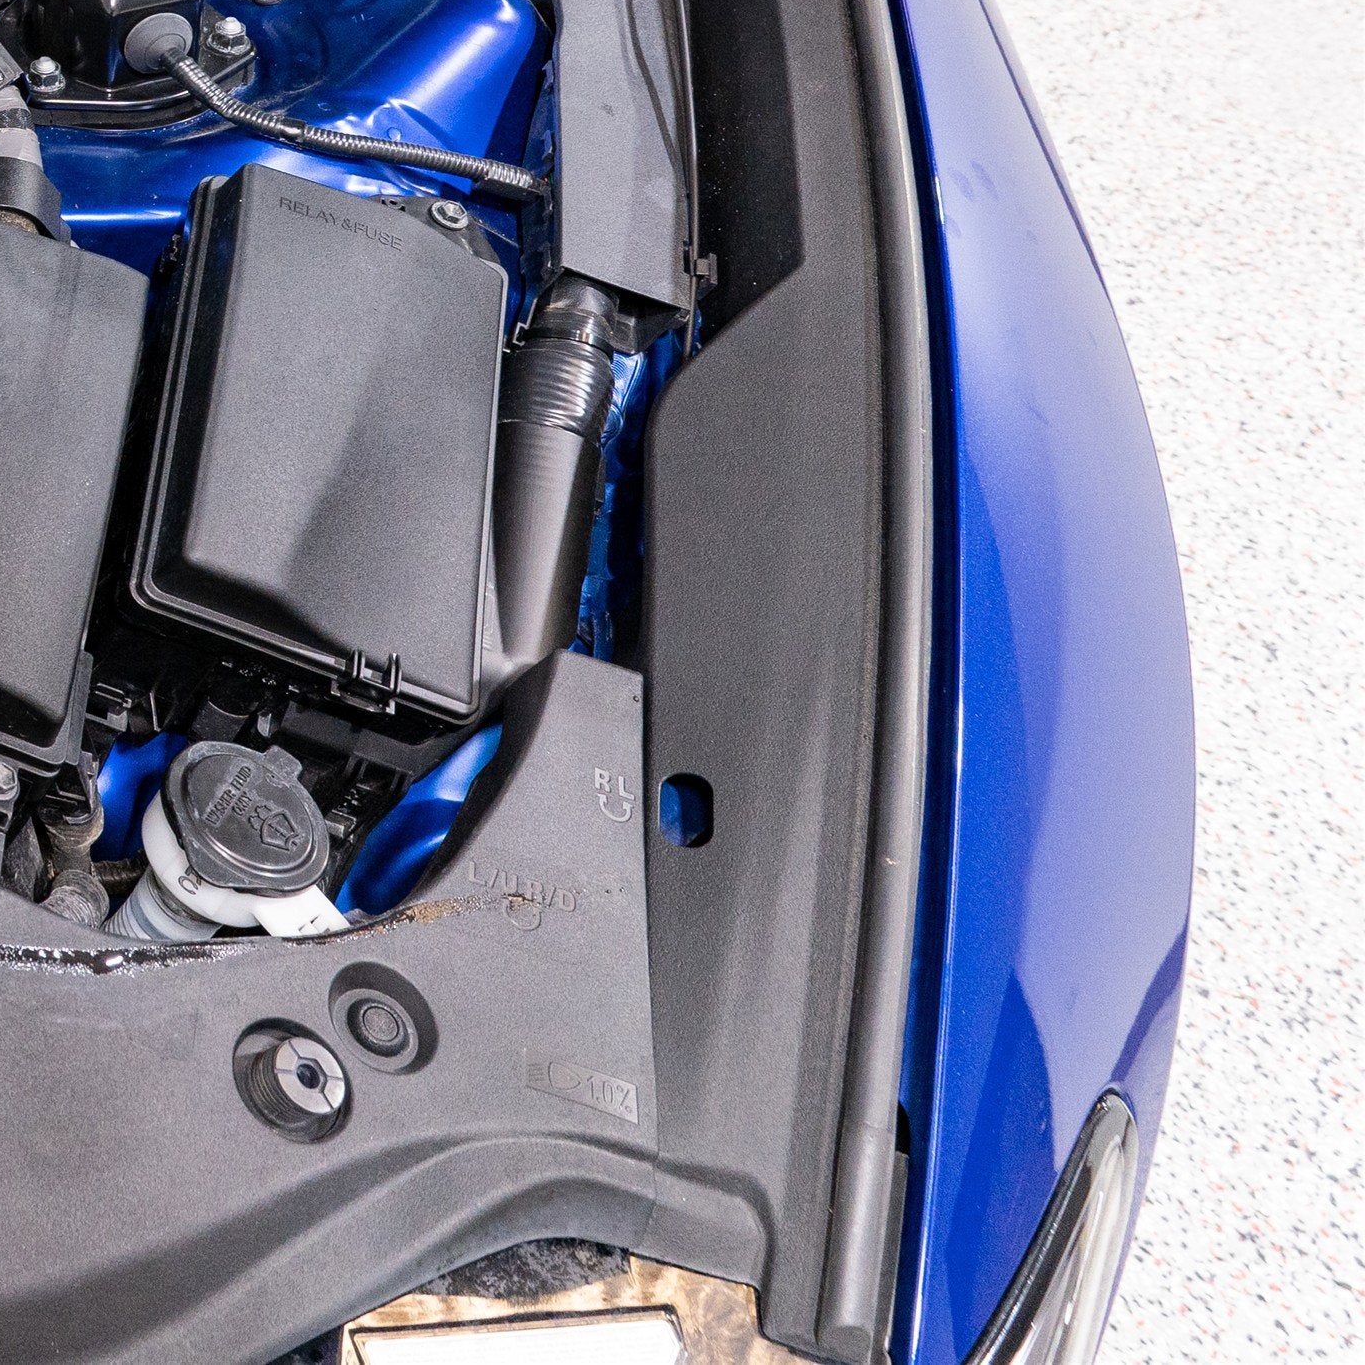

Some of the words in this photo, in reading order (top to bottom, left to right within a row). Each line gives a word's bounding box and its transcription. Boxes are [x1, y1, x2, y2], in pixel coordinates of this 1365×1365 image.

[593, 766, 613, 793] R
[617, 775, 636, 801] L
[204, 788, 237, 826] WASHER
[230, 791, 254, 818] ONLY
